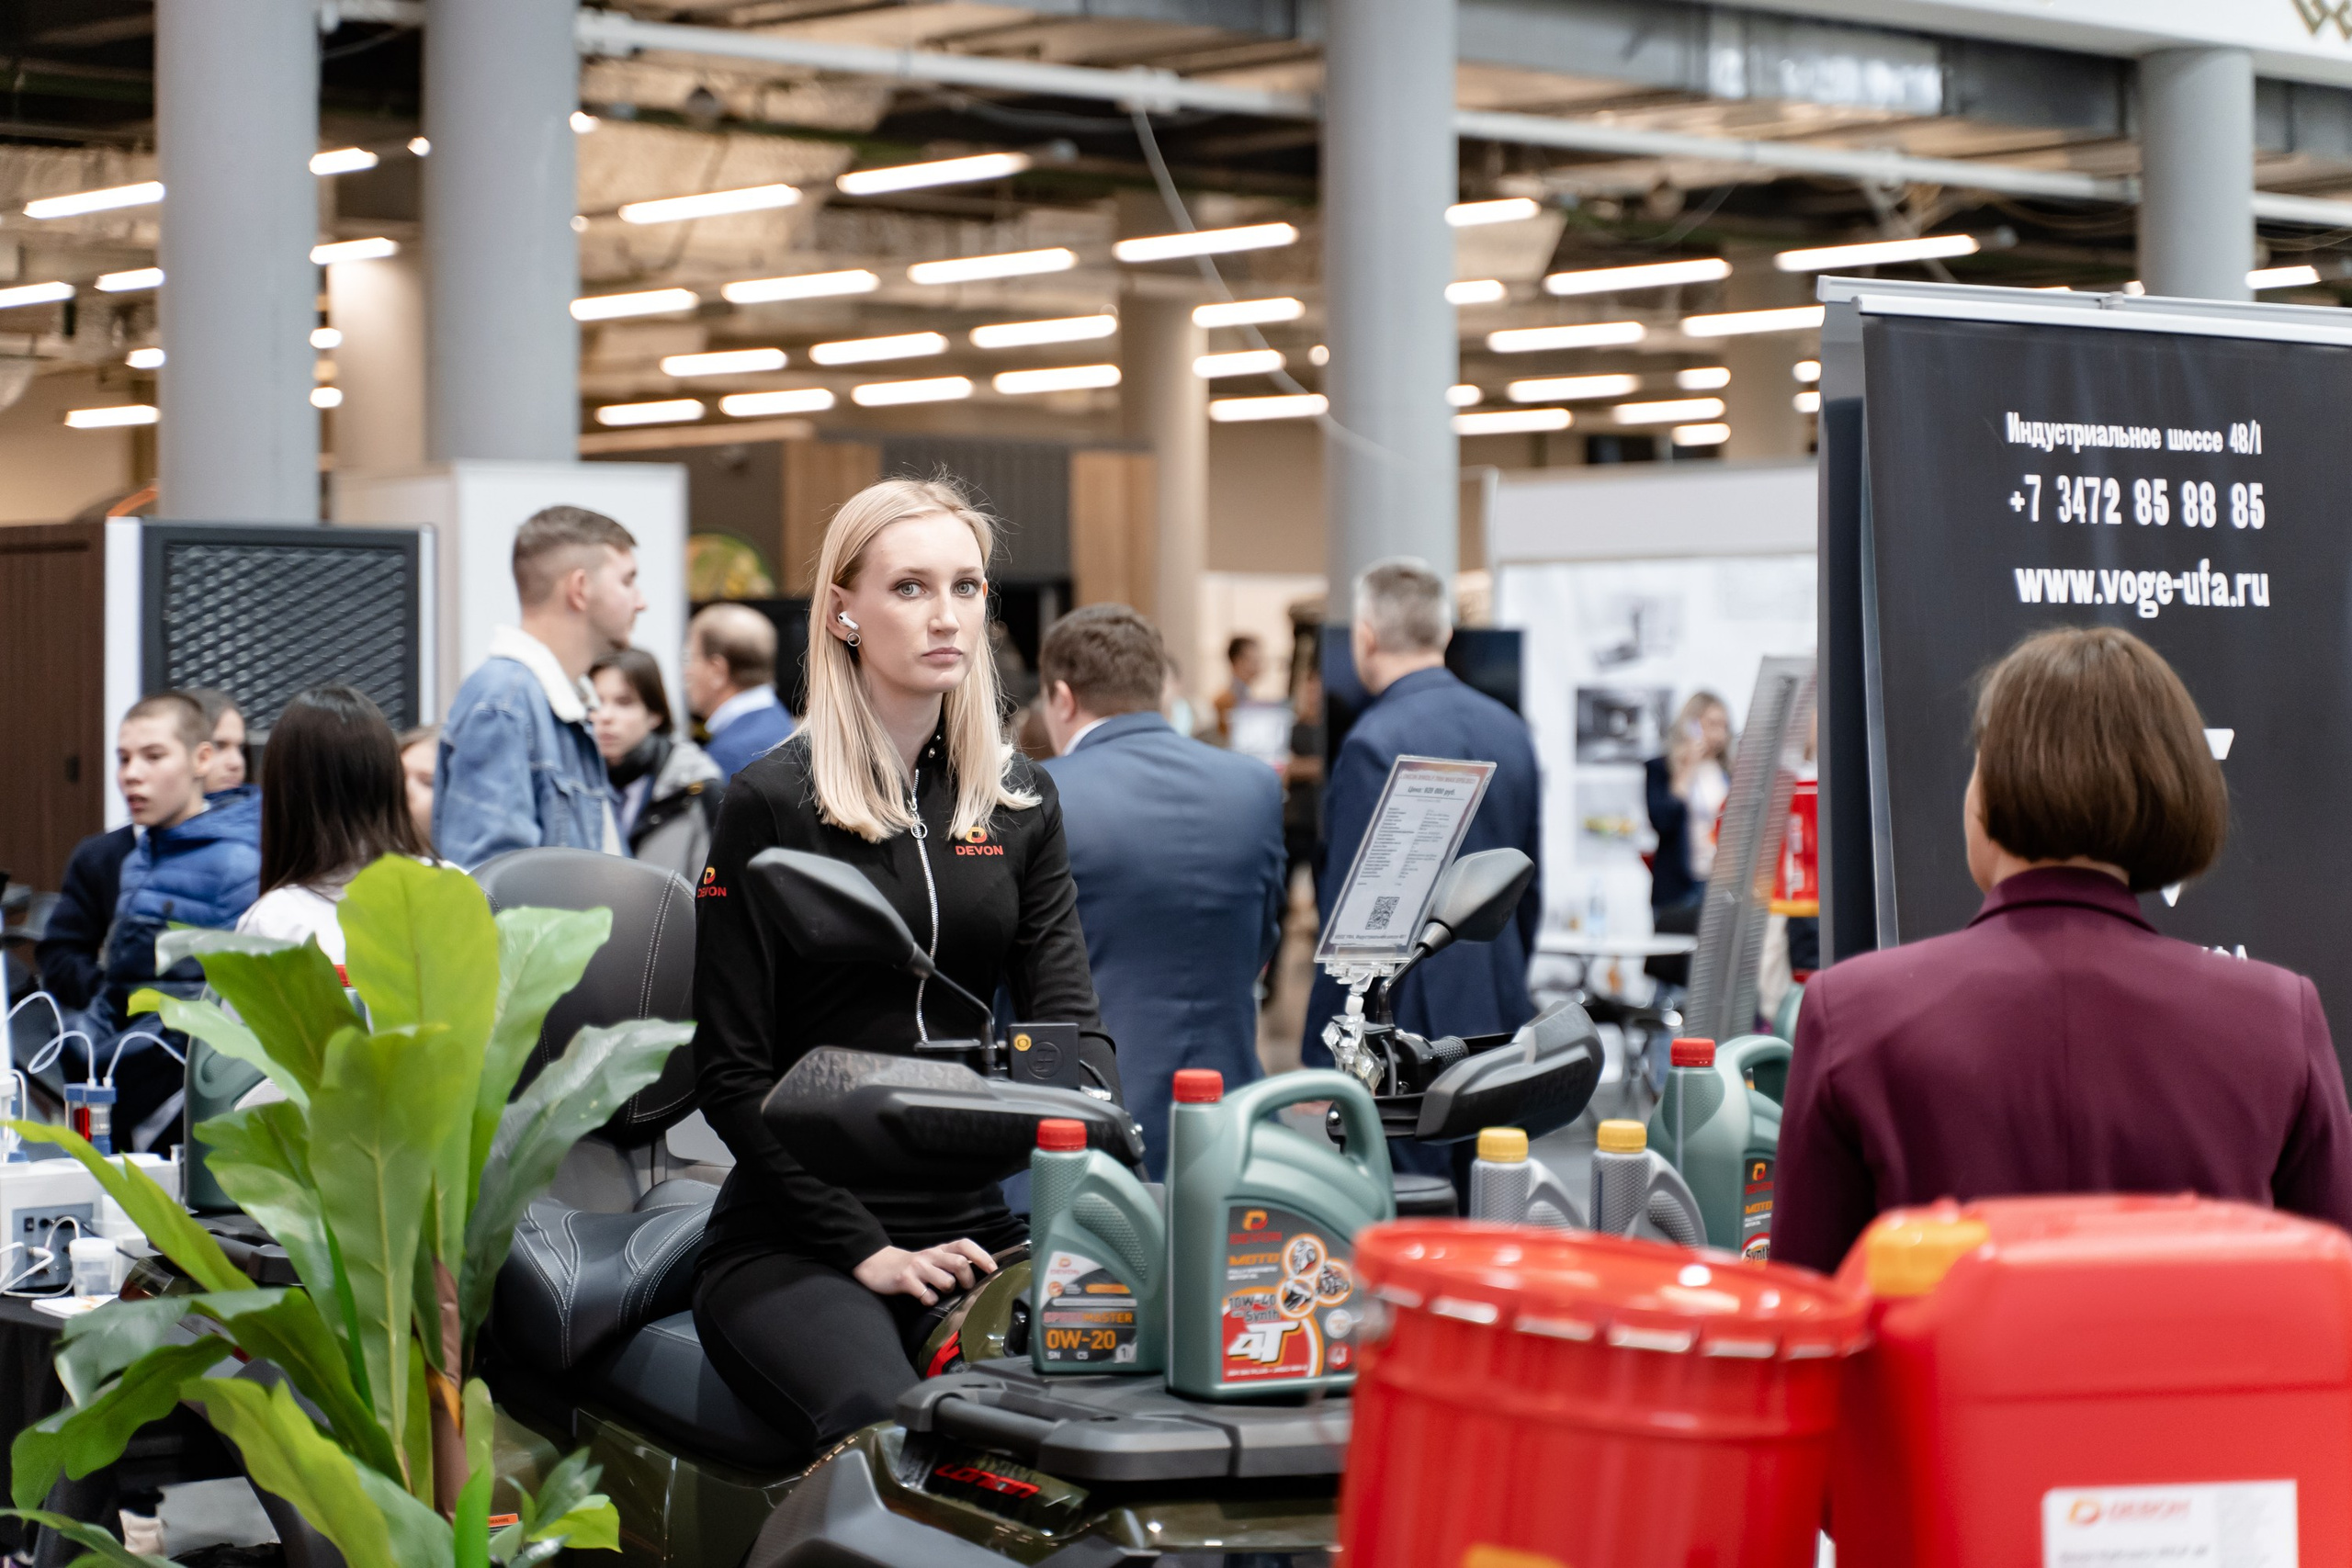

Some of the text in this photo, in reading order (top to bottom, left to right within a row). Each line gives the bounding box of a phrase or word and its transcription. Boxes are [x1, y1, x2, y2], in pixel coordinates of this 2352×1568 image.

[2007, 412, 2161, 453] Индустриальное
[2166, 428, 2223, 453] шоссе
[2009, 474, 2266, 530] +7 3472 85 88 85
[2015, 558, 2270, 618] www.voge-ufa.ru
[956, 845, 1004, 856] DEVON
[1745, 1201, 1773, 1214] MOTO
[1228, 1253, 1280, 1266] MOTO
[1245, 1310, 1281, 1323] Synth
[1046, 1330, 1116, 1349] 0W-20
[1227, 1321, 1302, 1364] 4T
